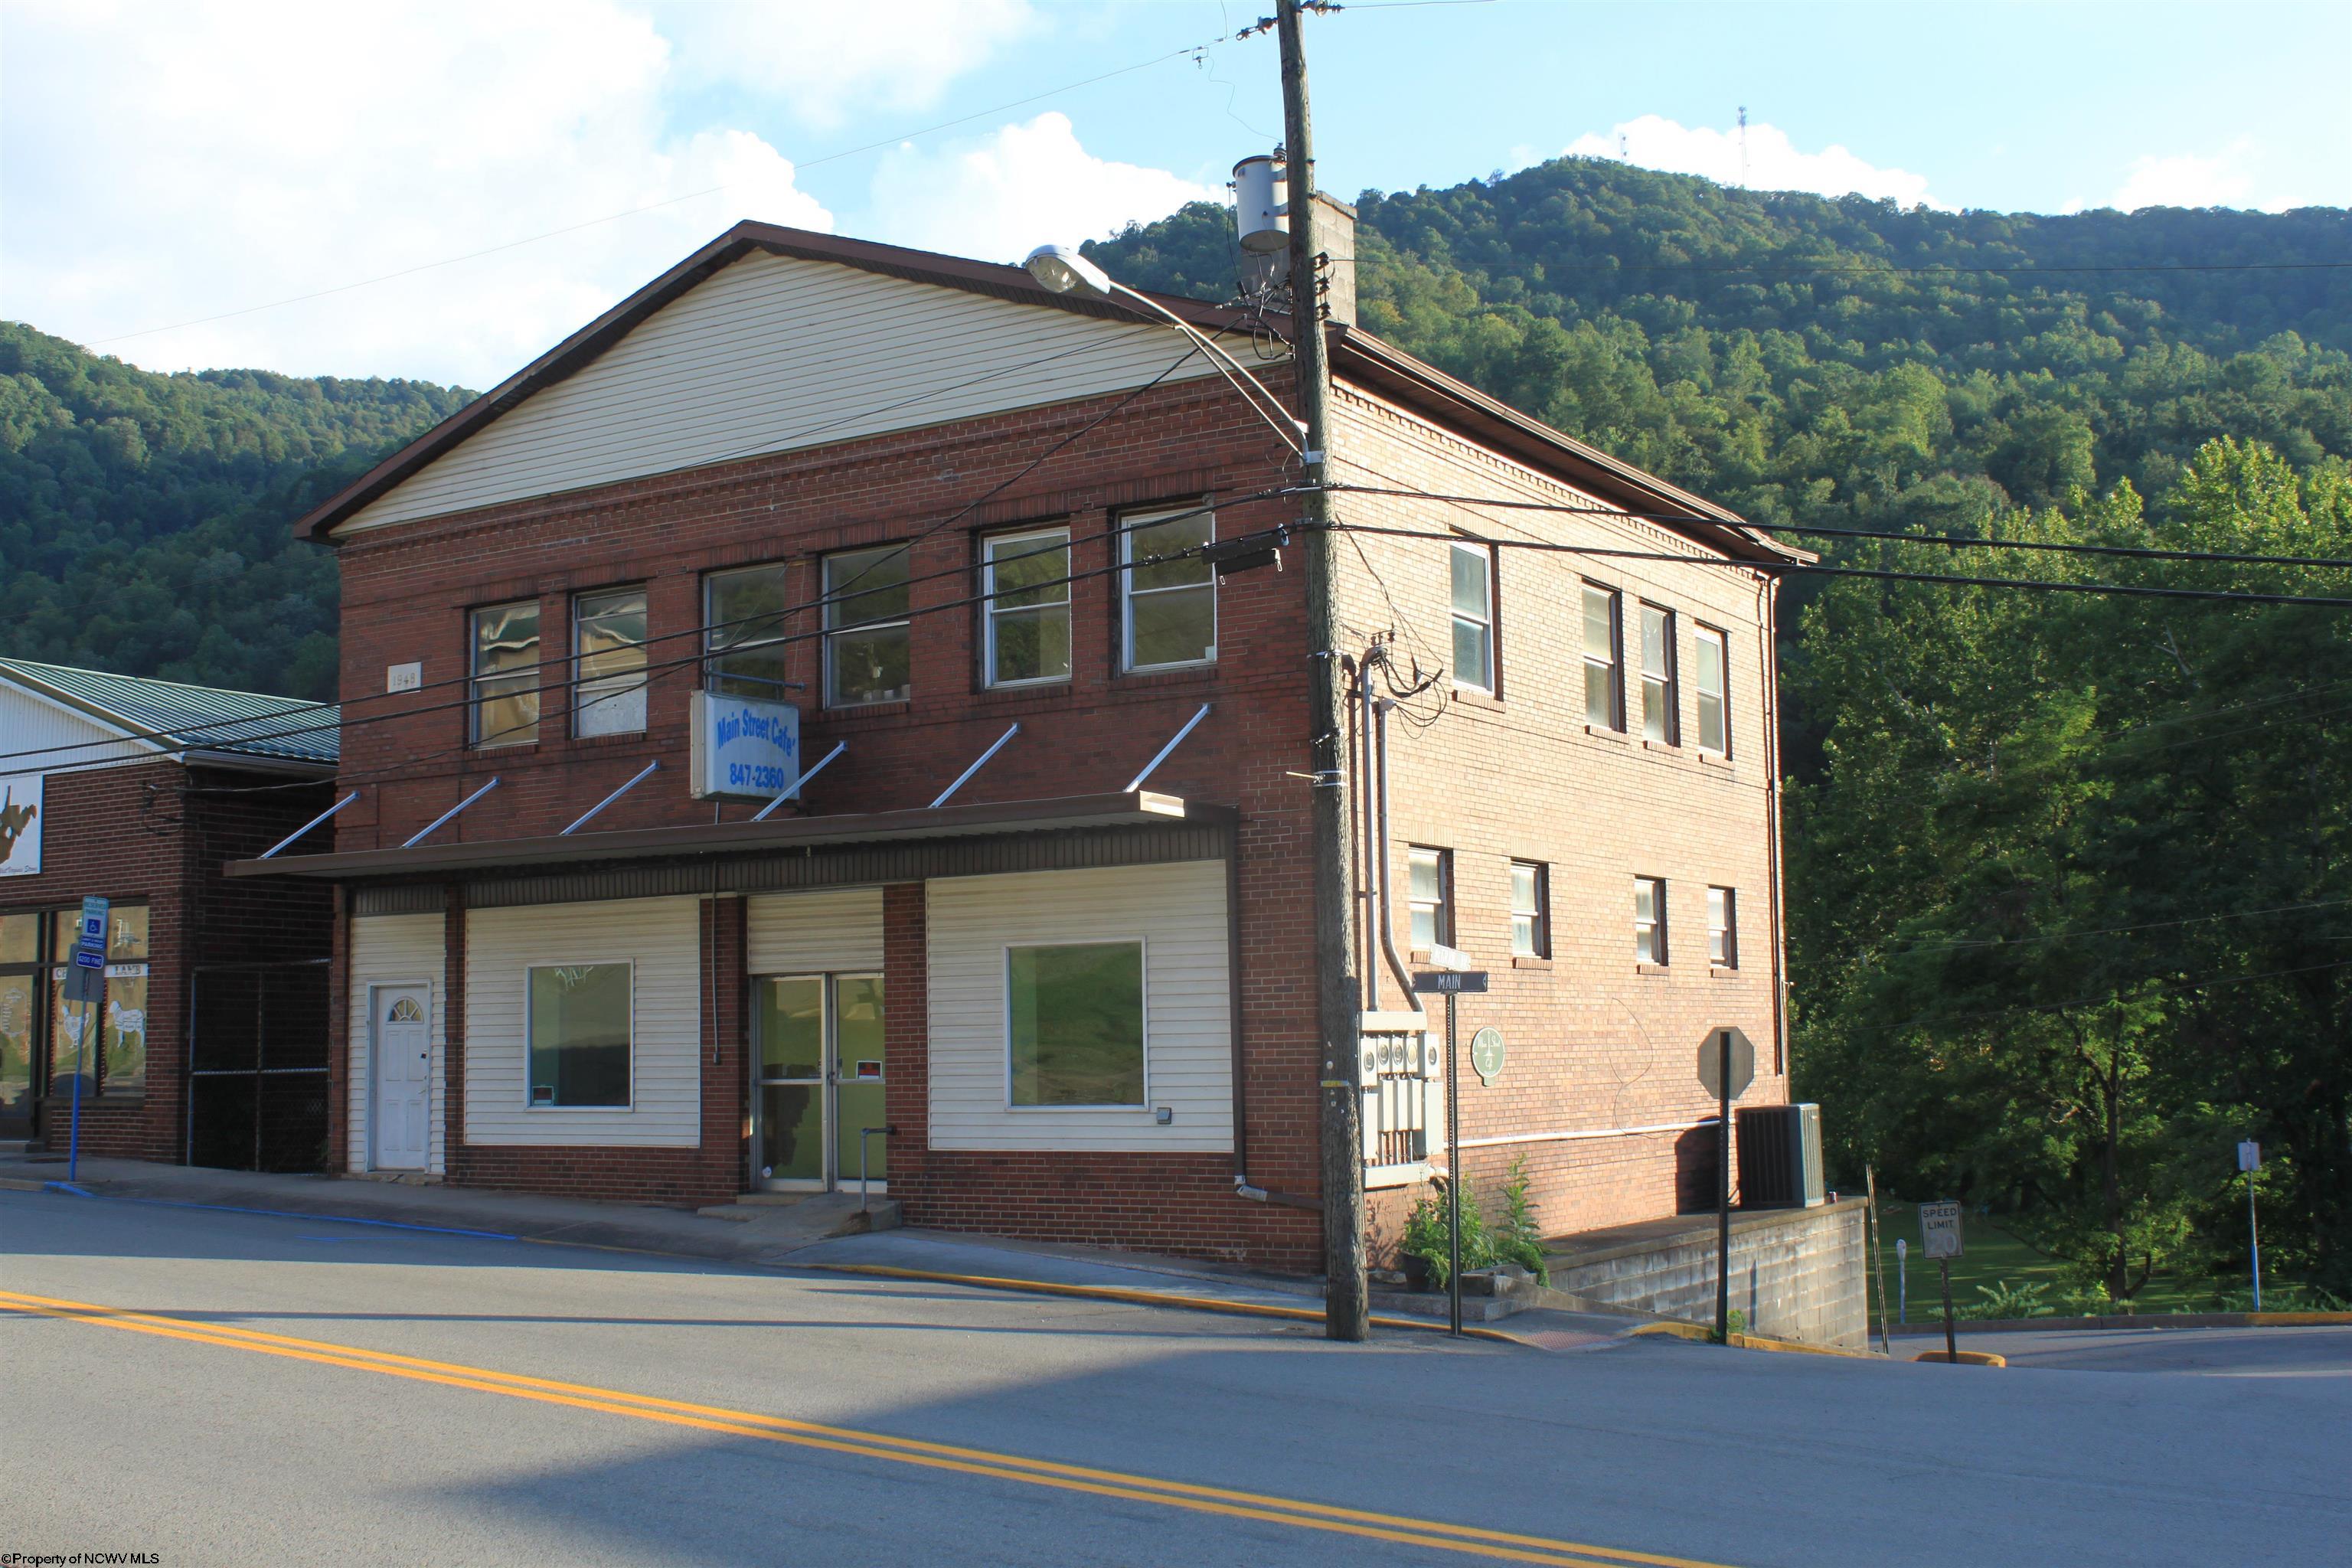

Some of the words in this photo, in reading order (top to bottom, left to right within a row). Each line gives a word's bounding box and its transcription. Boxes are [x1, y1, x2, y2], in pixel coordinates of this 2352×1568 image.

[393, 672, 416, 686] 1948
[717, 712, 740, 750] Main
[743, 708, 769, 740] Street
[81, 941, 104, 949] PARKING
[1438, 974, 1461, 989] MAIN
[1923, 1207, 1957, 1218] SPEED
[1928, 1220, 1954, 1230] LIMIT
